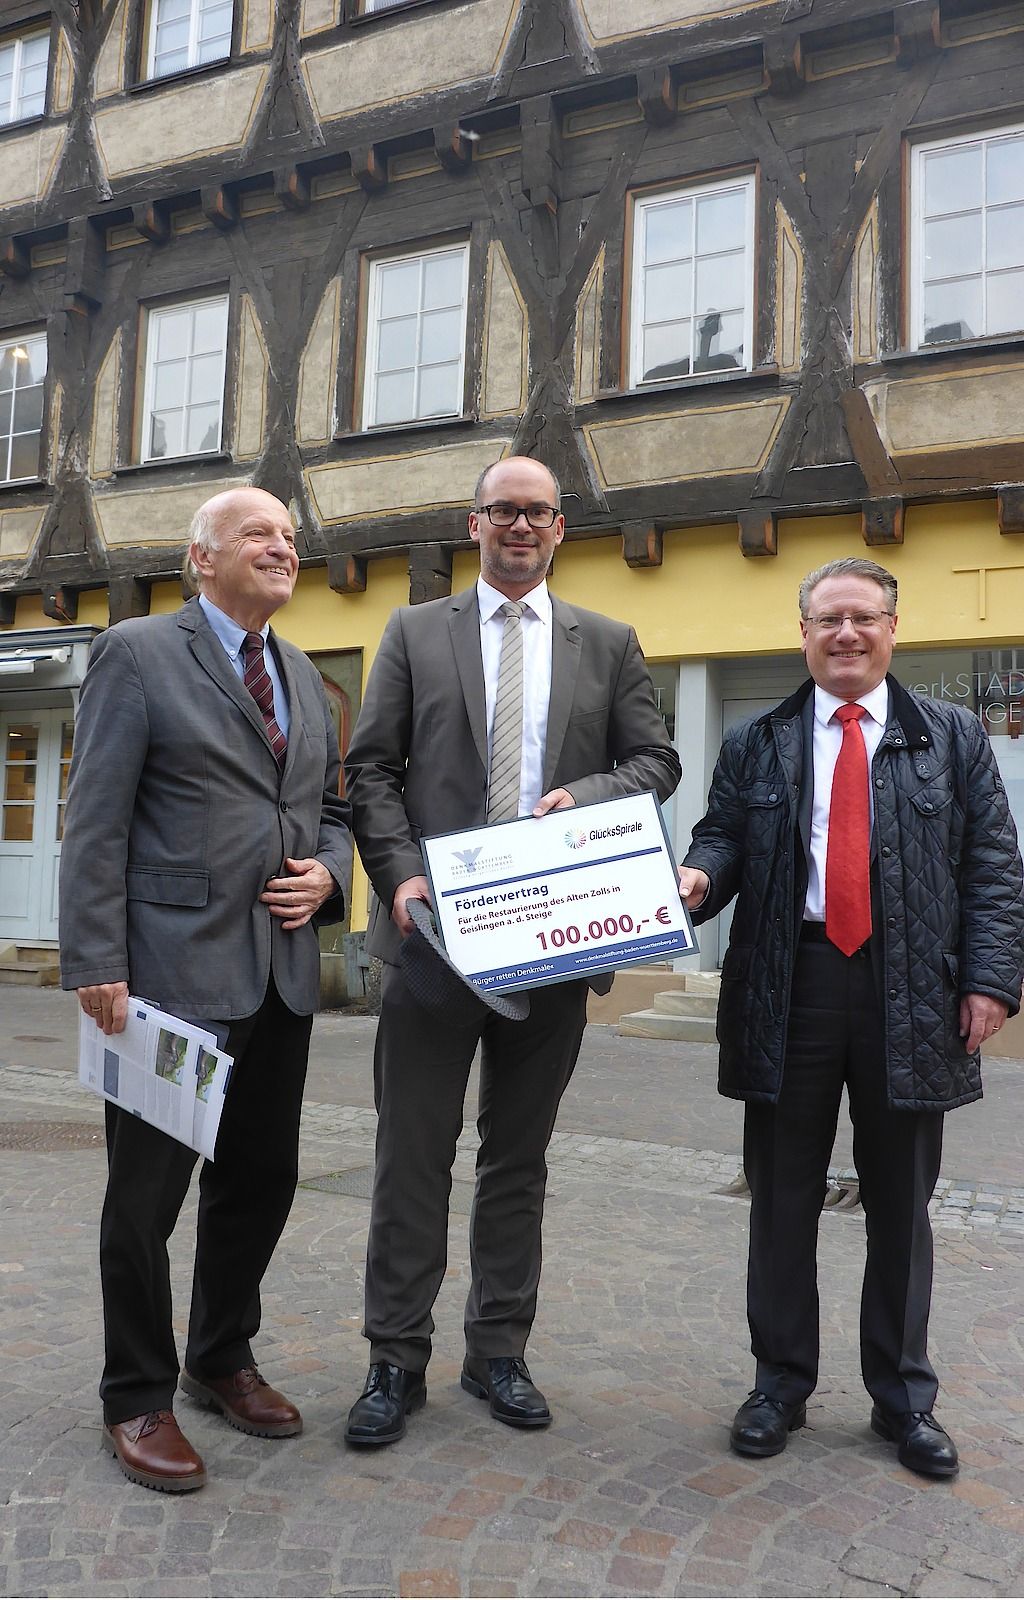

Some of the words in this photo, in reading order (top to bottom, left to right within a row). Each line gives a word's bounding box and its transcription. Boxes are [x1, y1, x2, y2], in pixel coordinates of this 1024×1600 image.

[589, 821, 643, 841] GlücksSpirale
[455, 885, 549, 912] Fördervertrag
[458, 917, 472, 925] Für
[474, 913, 487, 922] die
[489, 901, 548, 919] Restaurierung
[549, 898, 565, 906] des
[566, 893, 589, 903] Alten
[590, 887, 611, 898] Zolls
[612, 885, 621, 893] in
[460, 920, 505, 935] Geislingen
[516, 915, 525, 923] d.
[525, 910, 553, 921] Steige
[536, 914, 650, 950] 100.000,-
[655, 906, 672, 924] €
[496, 970, 517, 981] retten
